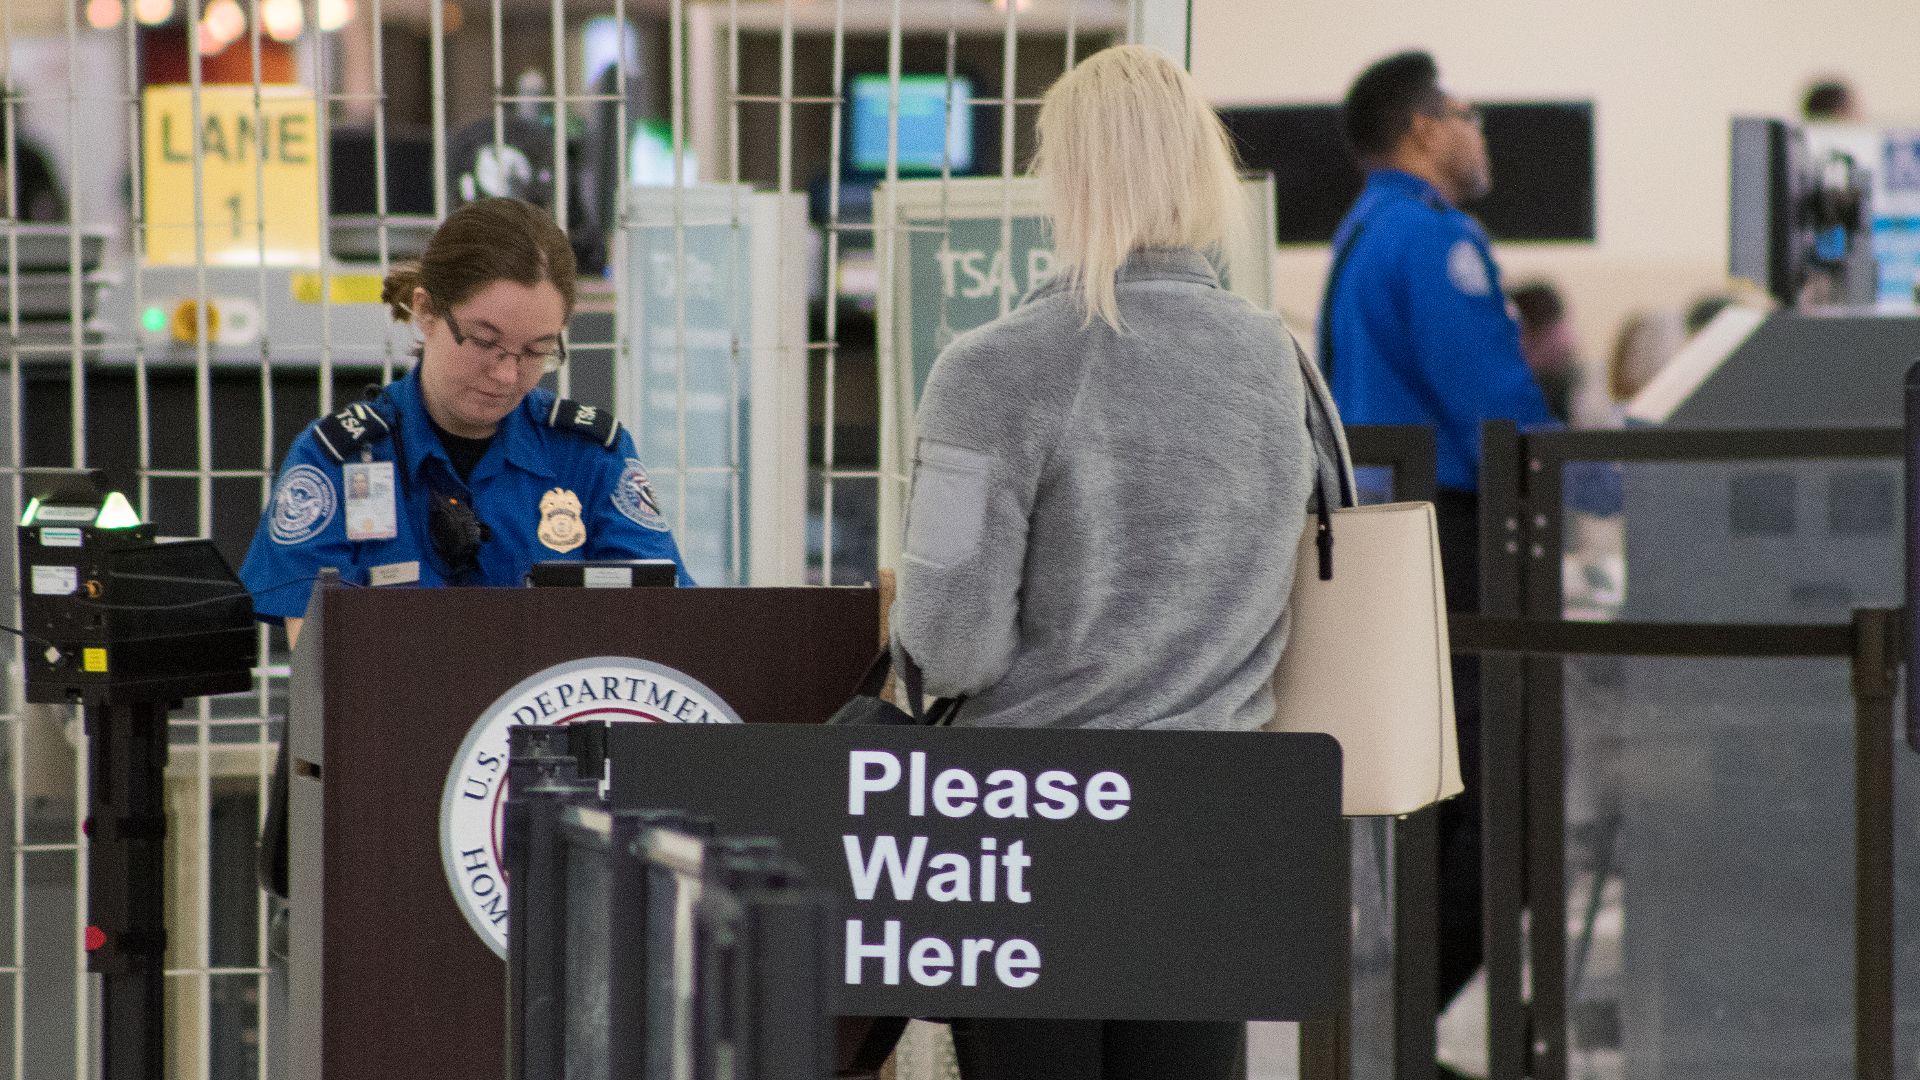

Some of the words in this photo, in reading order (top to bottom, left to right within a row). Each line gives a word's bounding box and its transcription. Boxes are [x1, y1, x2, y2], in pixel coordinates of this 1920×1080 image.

[161, 112, 309, 164] LANE
[223, 193, 243, 239] 1
[934, 250, 1017, 298] TSA
[334, 408, 366, 440] TSA
[464, 751, 506, 801] U.S.
[849, 750, 1131, 820] Please
[462, 847, 509, 931] HOM
[842, 835, 1031, 903] Wait
[845, 919, 1041, 988] Here
